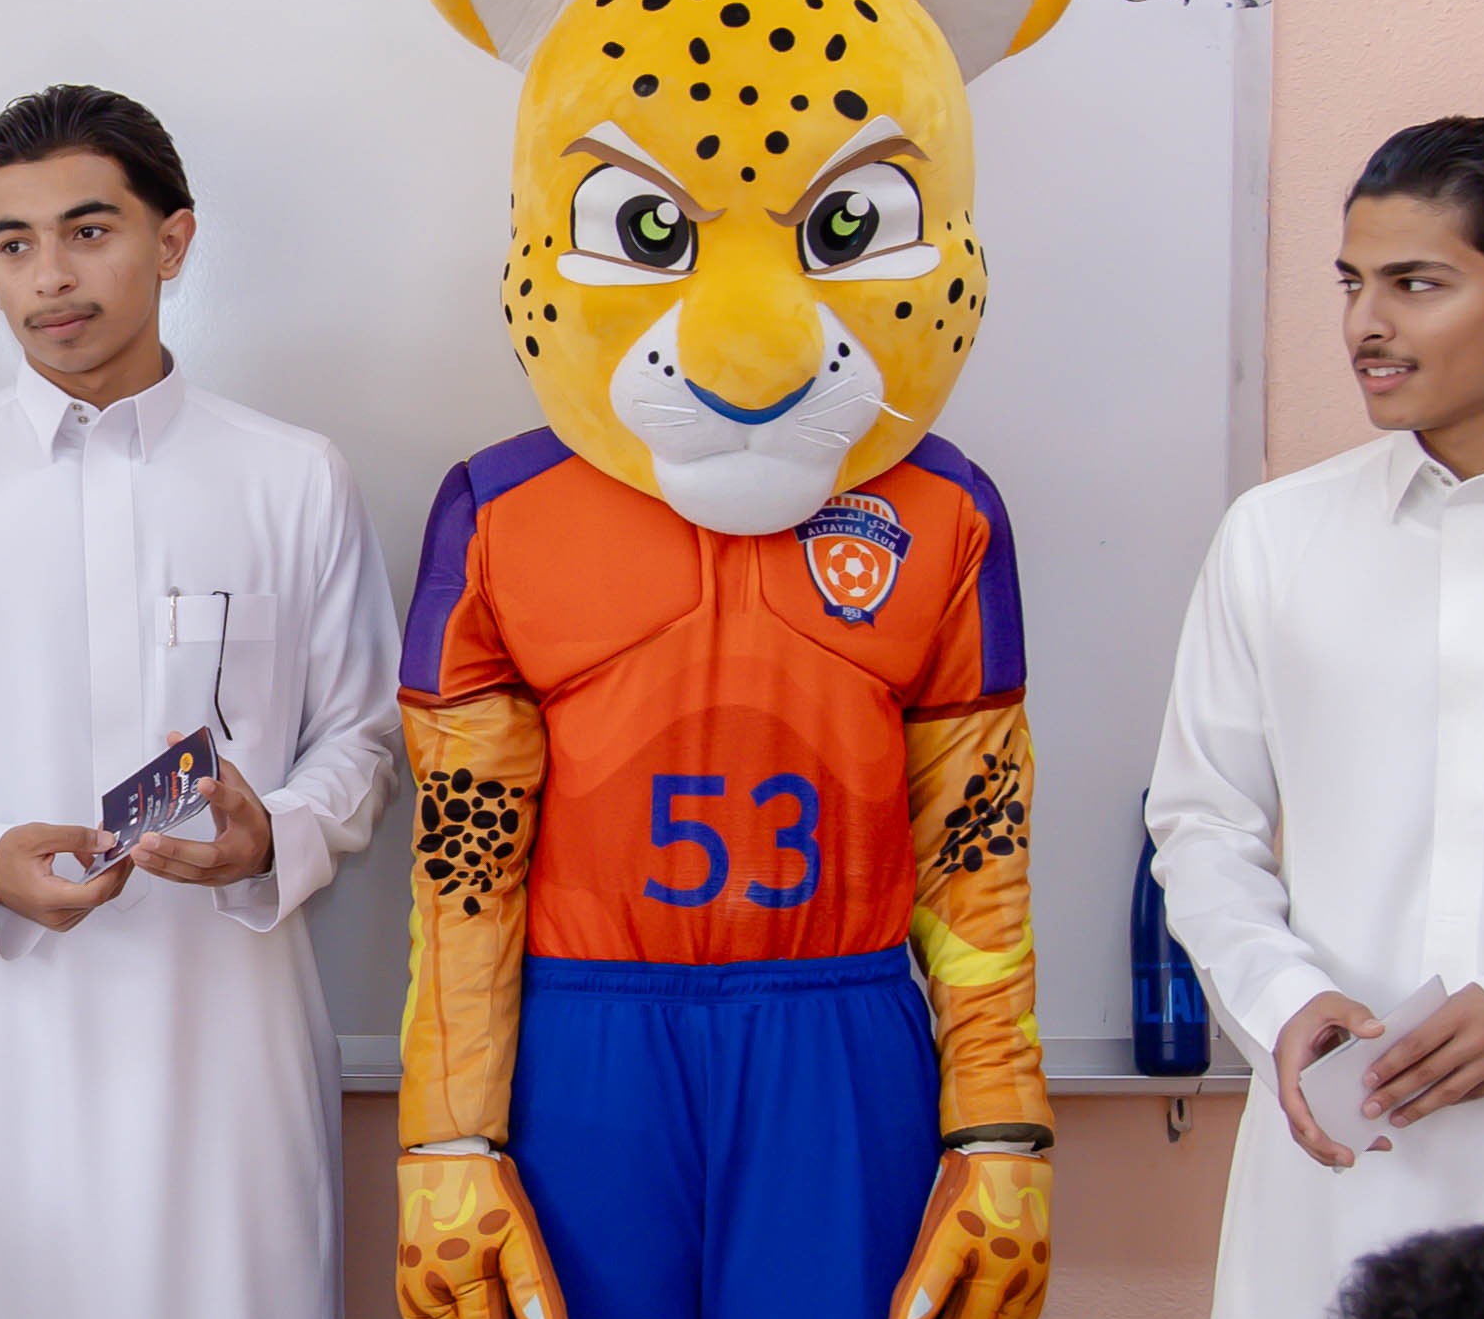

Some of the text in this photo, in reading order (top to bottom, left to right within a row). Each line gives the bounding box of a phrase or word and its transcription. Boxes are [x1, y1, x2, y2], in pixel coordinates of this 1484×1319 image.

[807, 523, 897, 551] ALFAYHA CLUB
[643, 772, 822, 910] 53
